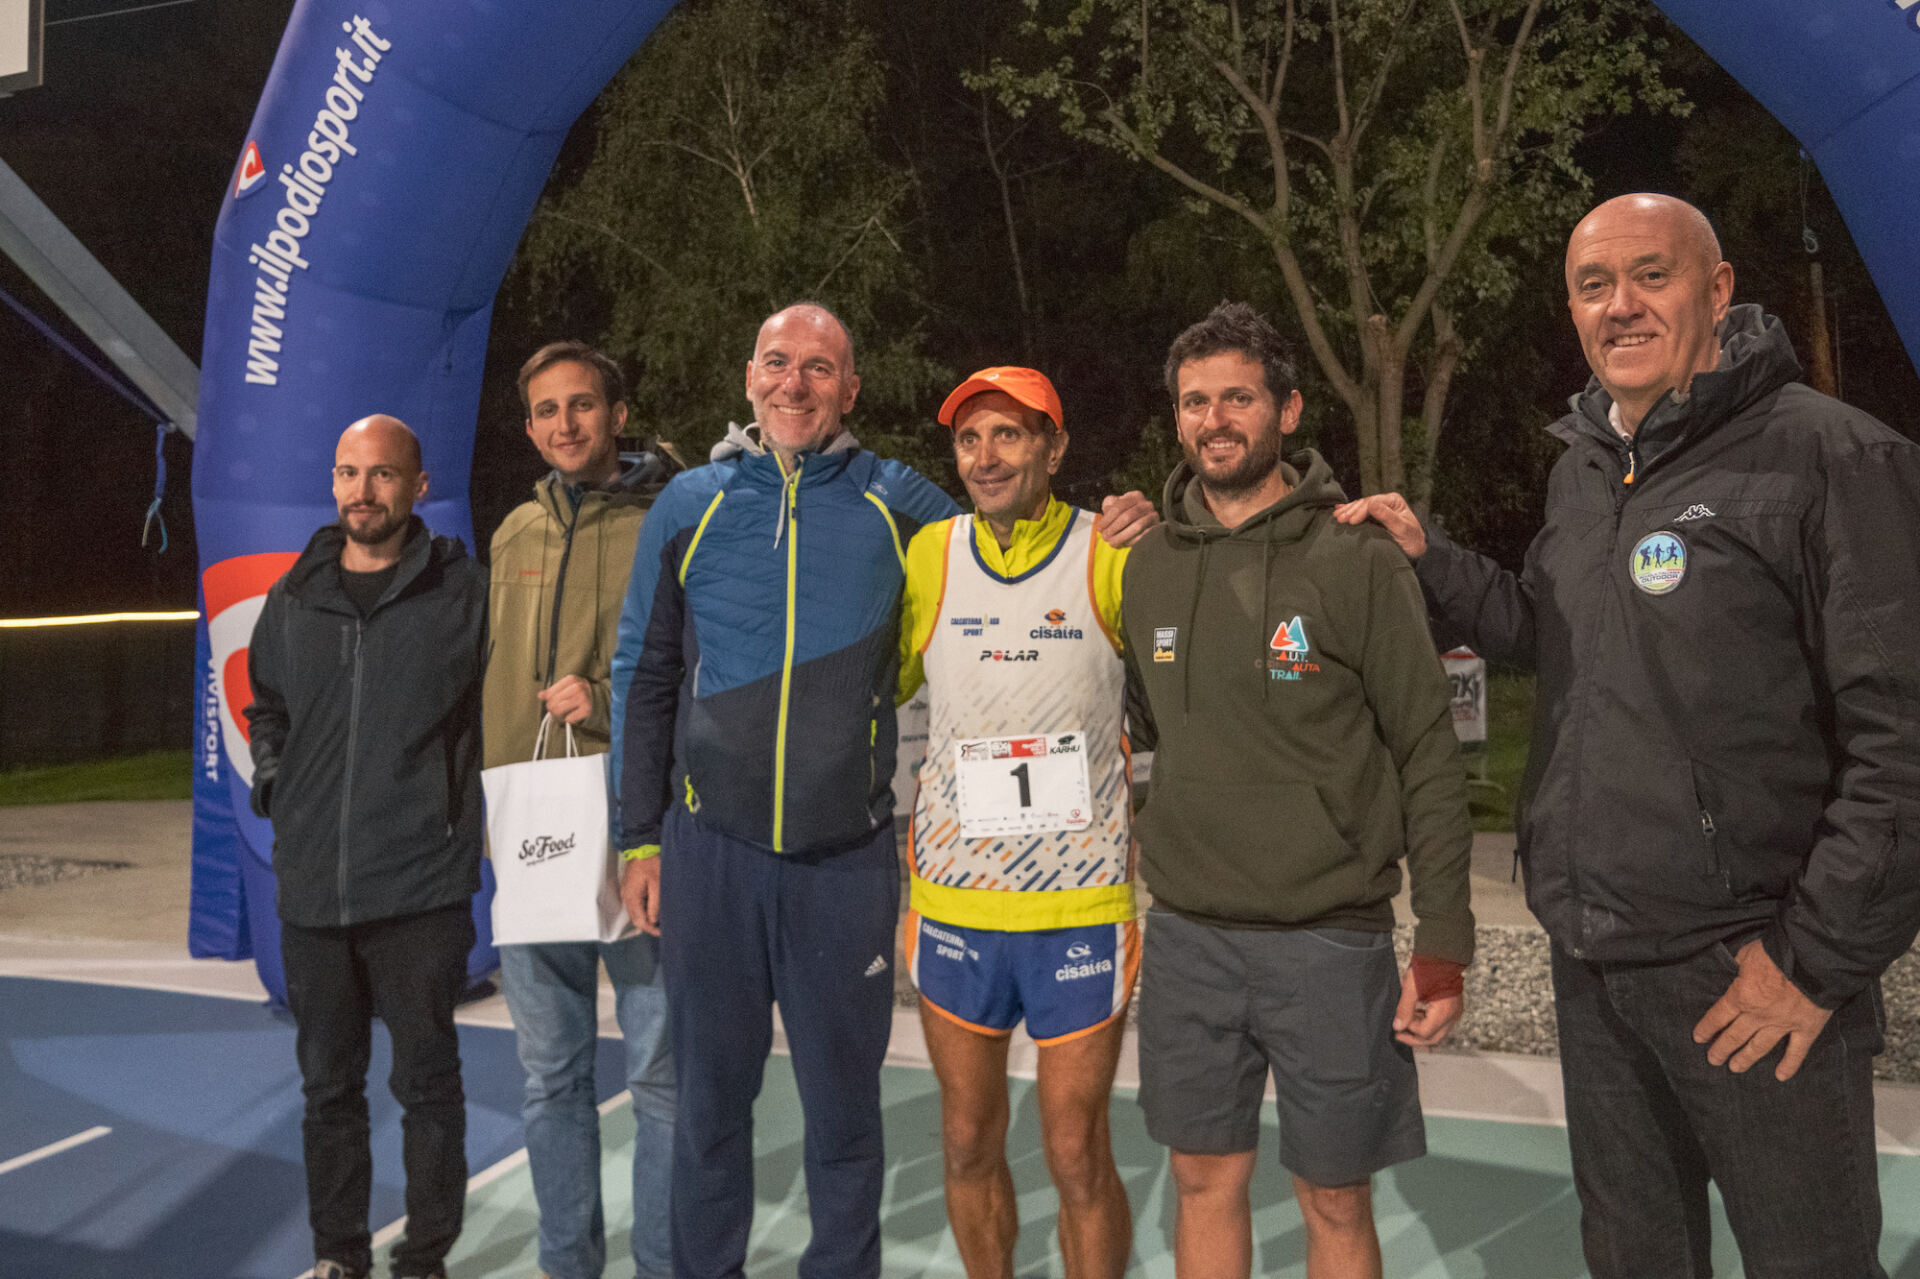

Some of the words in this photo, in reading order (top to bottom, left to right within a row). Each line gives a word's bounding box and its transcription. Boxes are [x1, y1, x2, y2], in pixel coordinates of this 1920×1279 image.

[245, 14, 392, 386] www.ilpodiosport.it
[1029, 627, 1083, 640] cisalfa
[980, 650, 1039, 661] POLAR
[1270, 669, 1302, 680] TRAIL
[1049, 745, 1080, 754] KARHU
[1010, 763, 1031, 807] 1
[1055, 958, 1112, 981] cisalfa
